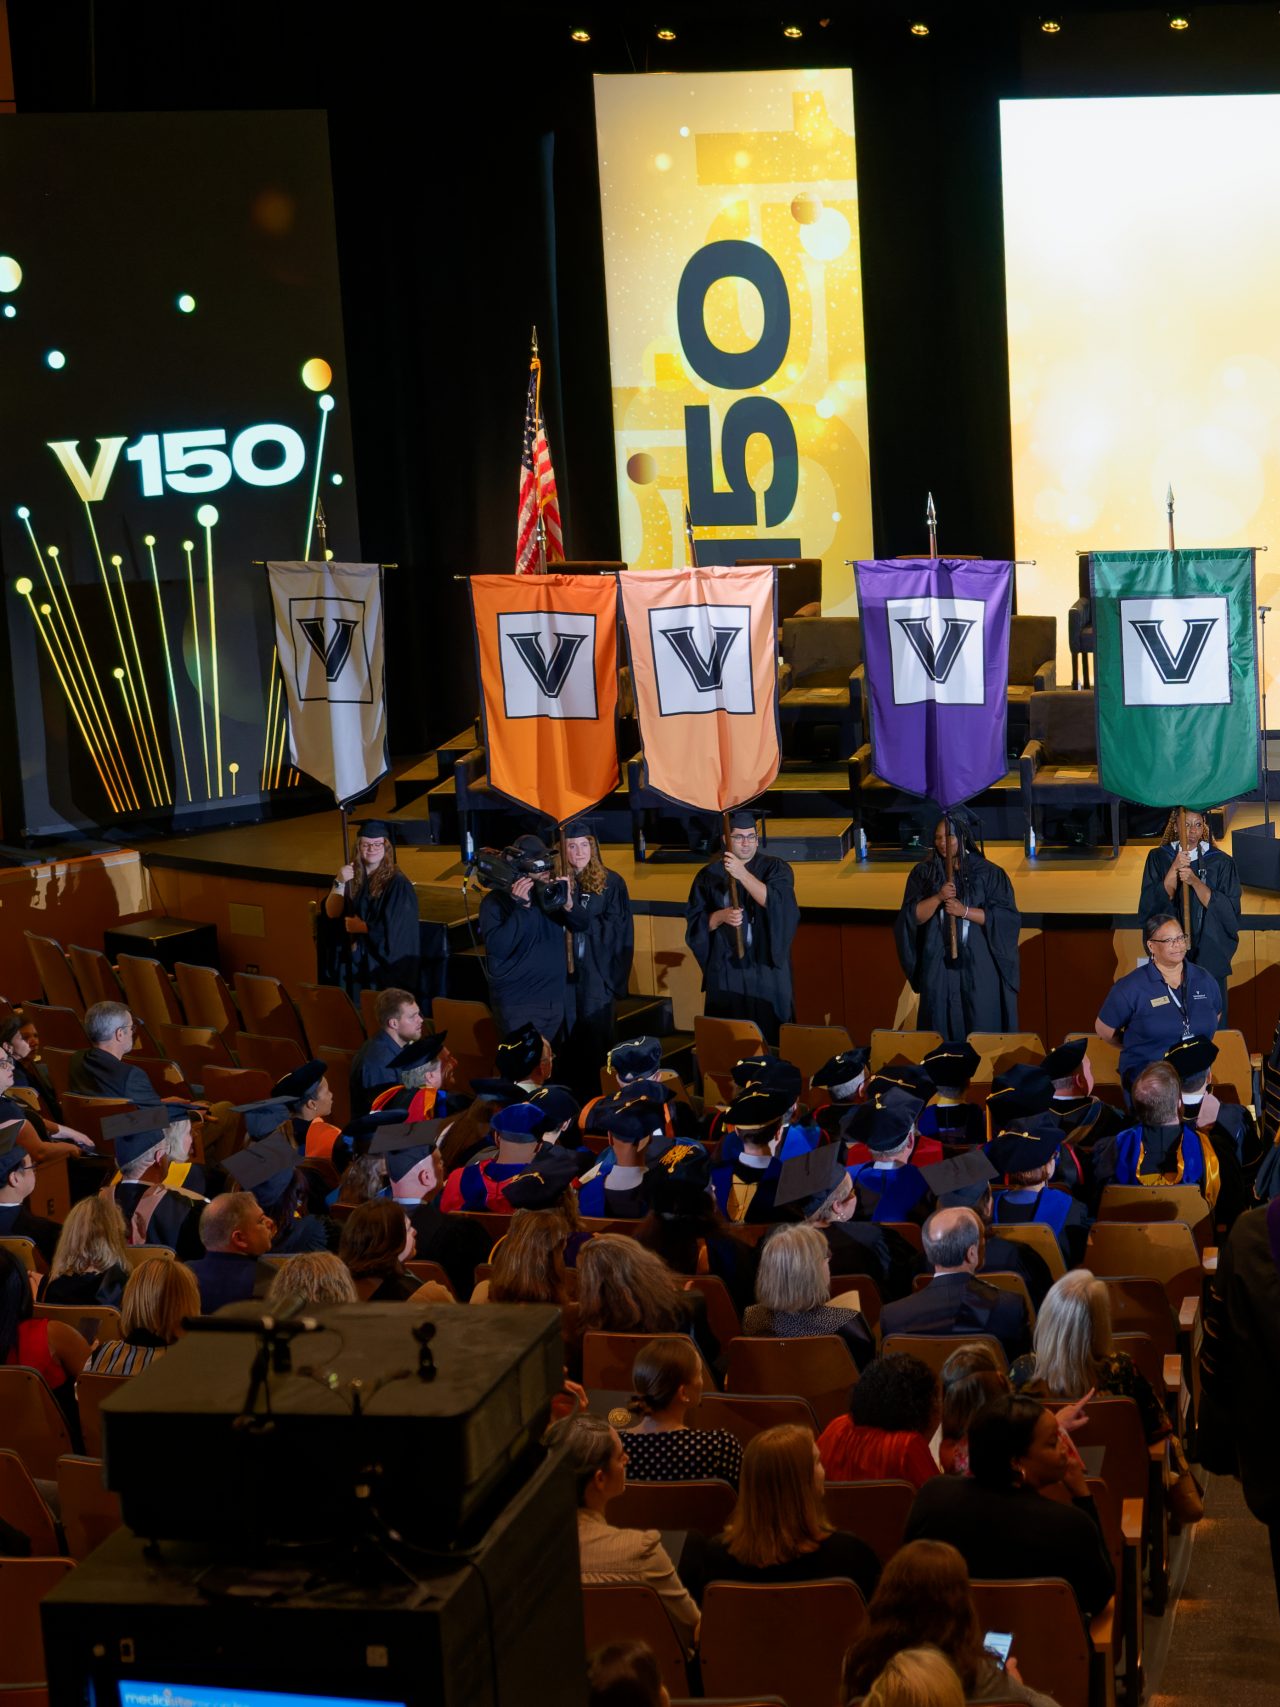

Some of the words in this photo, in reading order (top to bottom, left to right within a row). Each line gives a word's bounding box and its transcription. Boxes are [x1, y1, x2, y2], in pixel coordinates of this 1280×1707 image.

[47, 424, 306, 502] V150
[296, 617, 359, 682] V
[506, 632, 588, 698] V
[658, 627, 744, 692] V
[894, 616, 977, 684] V
[1128, 618, 1220, 684] V
